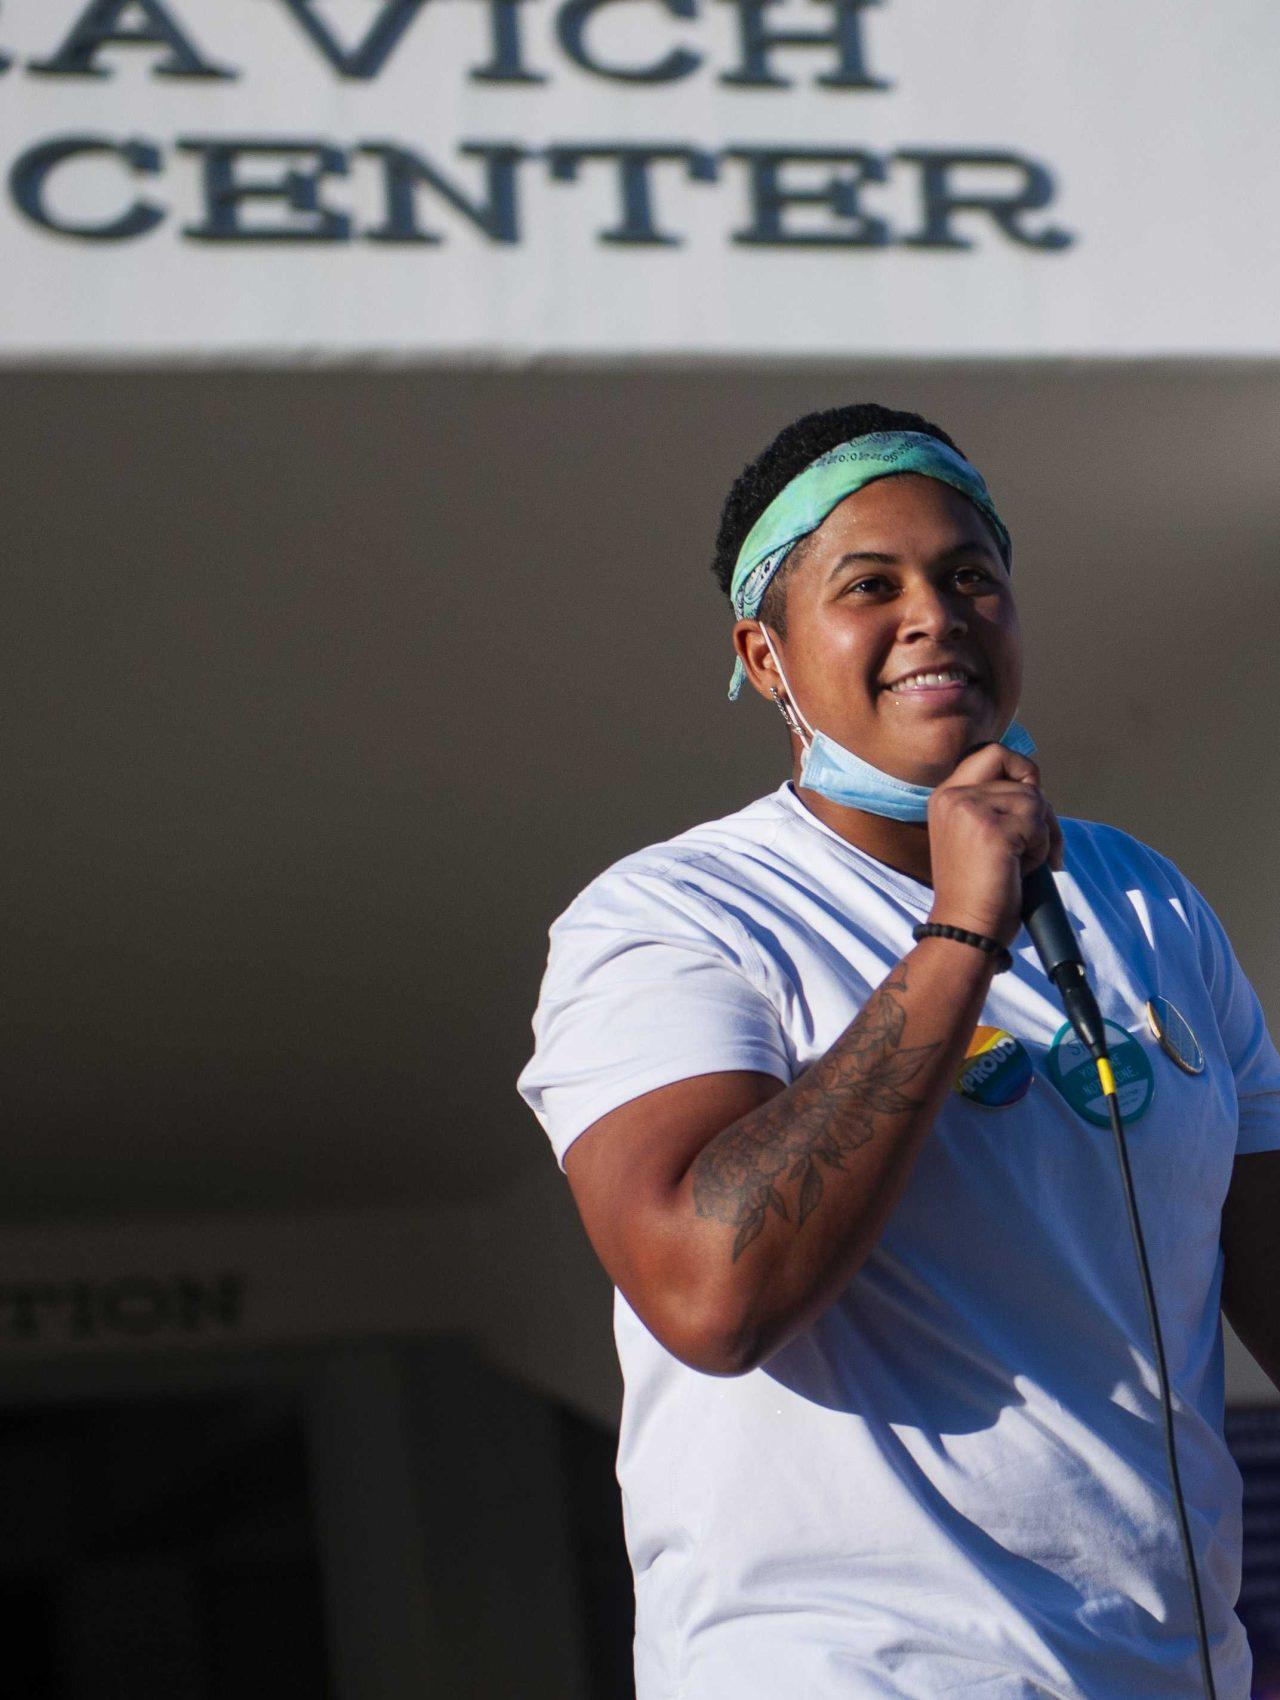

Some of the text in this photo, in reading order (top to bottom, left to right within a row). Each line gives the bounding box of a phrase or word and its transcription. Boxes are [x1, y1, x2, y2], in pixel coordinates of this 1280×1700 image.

[0, 0, 893, 92] AVICH
[8, 130, 1076, 252] CENTER
[961, 1037, 1017, 1091] PROUD
